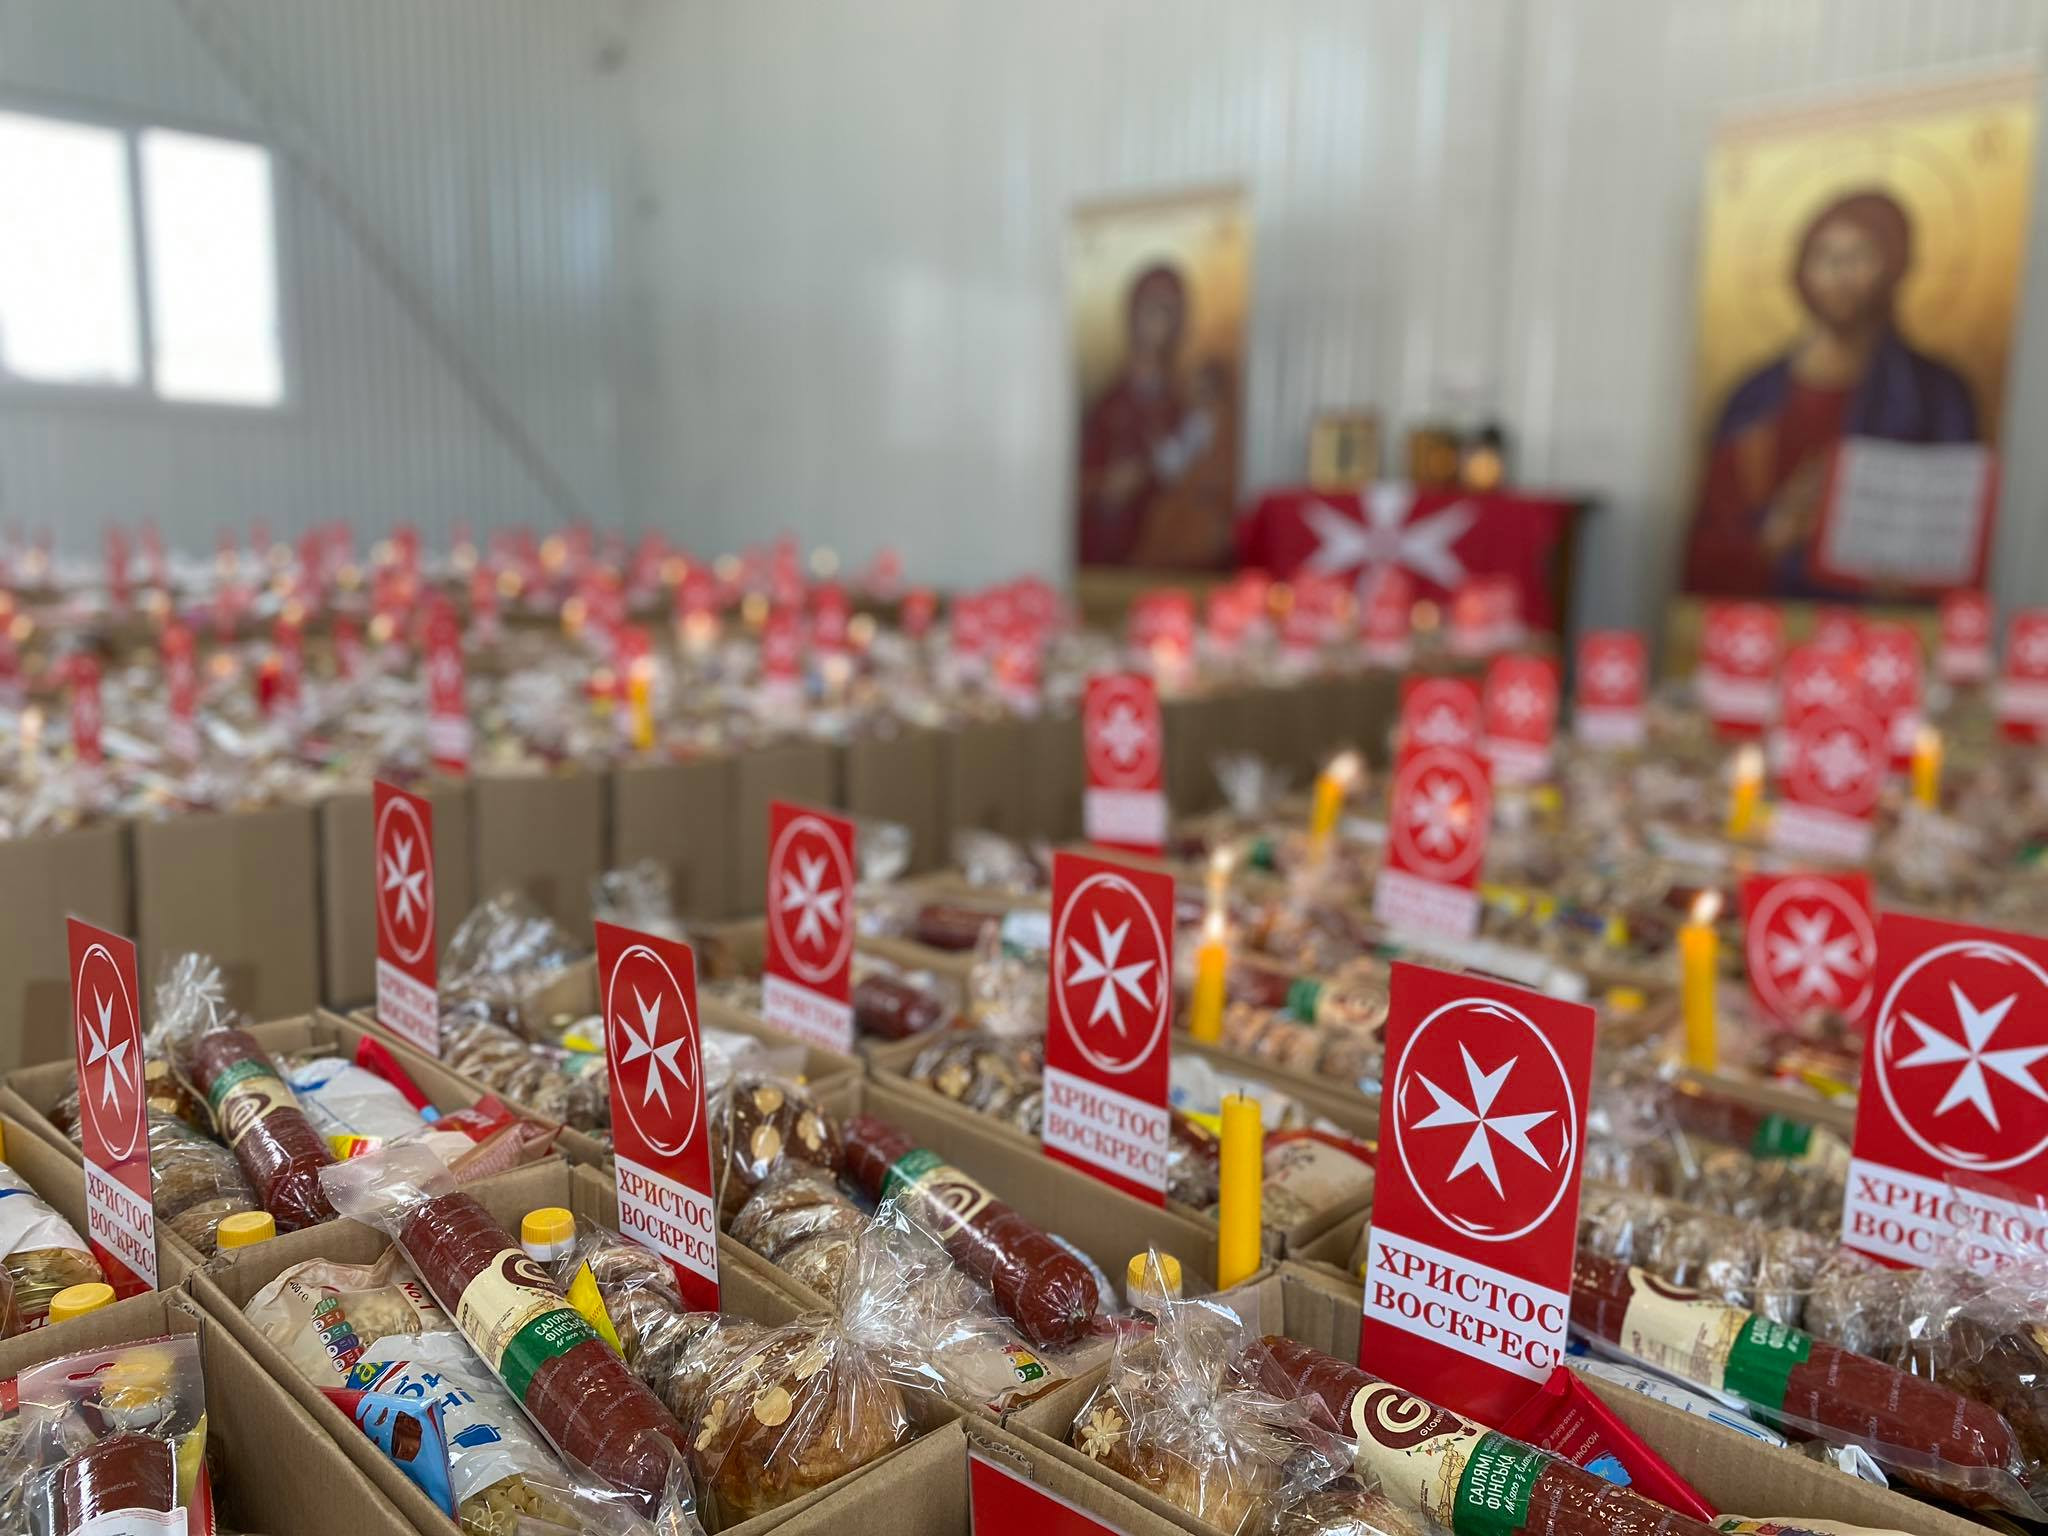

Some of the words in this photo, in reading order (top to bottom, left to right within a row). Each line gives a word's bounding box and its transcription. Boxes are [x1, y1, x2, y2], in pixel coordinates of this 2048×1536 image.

[1050, 1079, 1165, 1144] ХРИСТОС
[1049, 1112, 1165, 1179] ВОСКРЕС!
[87, 1171, 153, 1239] ХРИСТОС
[618, 1167, 712, 1234] ХРИСТОС
[90, 1205, 156, 1276] ВОСКРЕС!
[620, 1201, 716, 1270] ВОСКРЕС!
[1376, 1243, 1564, 1333] ХРИСТОС
[534, 1310, 575, 1336] САЛЯМІ
[1372, 1280, 1560, 1371] ВОСКРЕС!
[1468, 1453, 1495, 1506] САЛЯМІ
[1485, 1454, 1517, 1510] ФІНСЬКА
[1503, 1482, 1521, 1515] М'ясо
